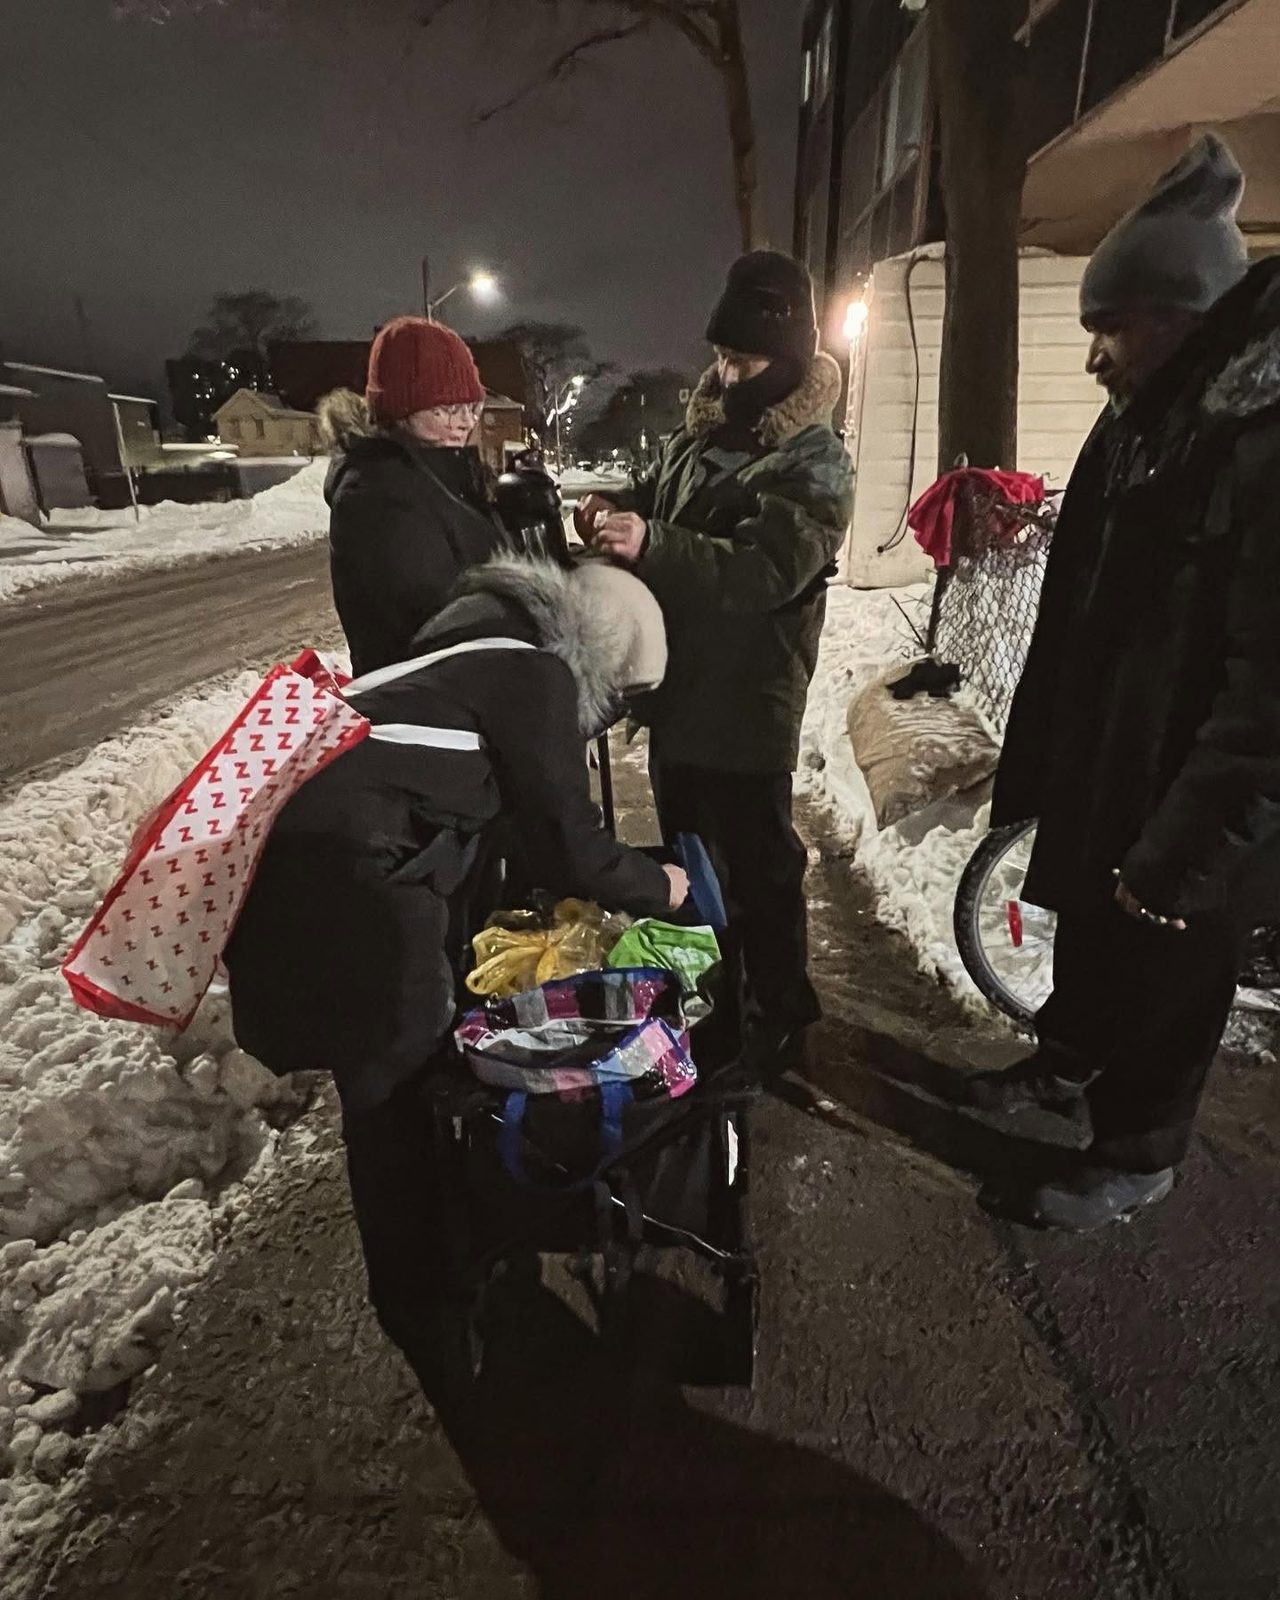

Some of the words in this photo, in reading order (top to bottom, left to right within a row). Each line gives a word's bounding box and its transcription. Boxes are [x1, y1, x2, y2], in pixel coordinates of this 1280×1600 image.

[286, 684, 300, 700] Z
[258, 708, 273, 725] Z
[285, 707, 300, 724] Z
[250, 734, 265, 751] Z
[278, 733, 292, 750] Z
[208, 766, 222, 784] Z
[234, 762, 250, 779] Z
[262, 759, 278, 776] Z
[211, 792, 226, 808] Z
[178, 827, 194, 842] Z
[207, 819, 222, 835] Z
[195, 848, 208, 864] Z
[166, 858, 182, 874] Z
[139, 869, 154, 885] Z
[202, 872, 216, 887] Z
[176, 884, 189, 897] Z
[148, 895, 162, 909] Z
[203, 899, 217, 914] Z
